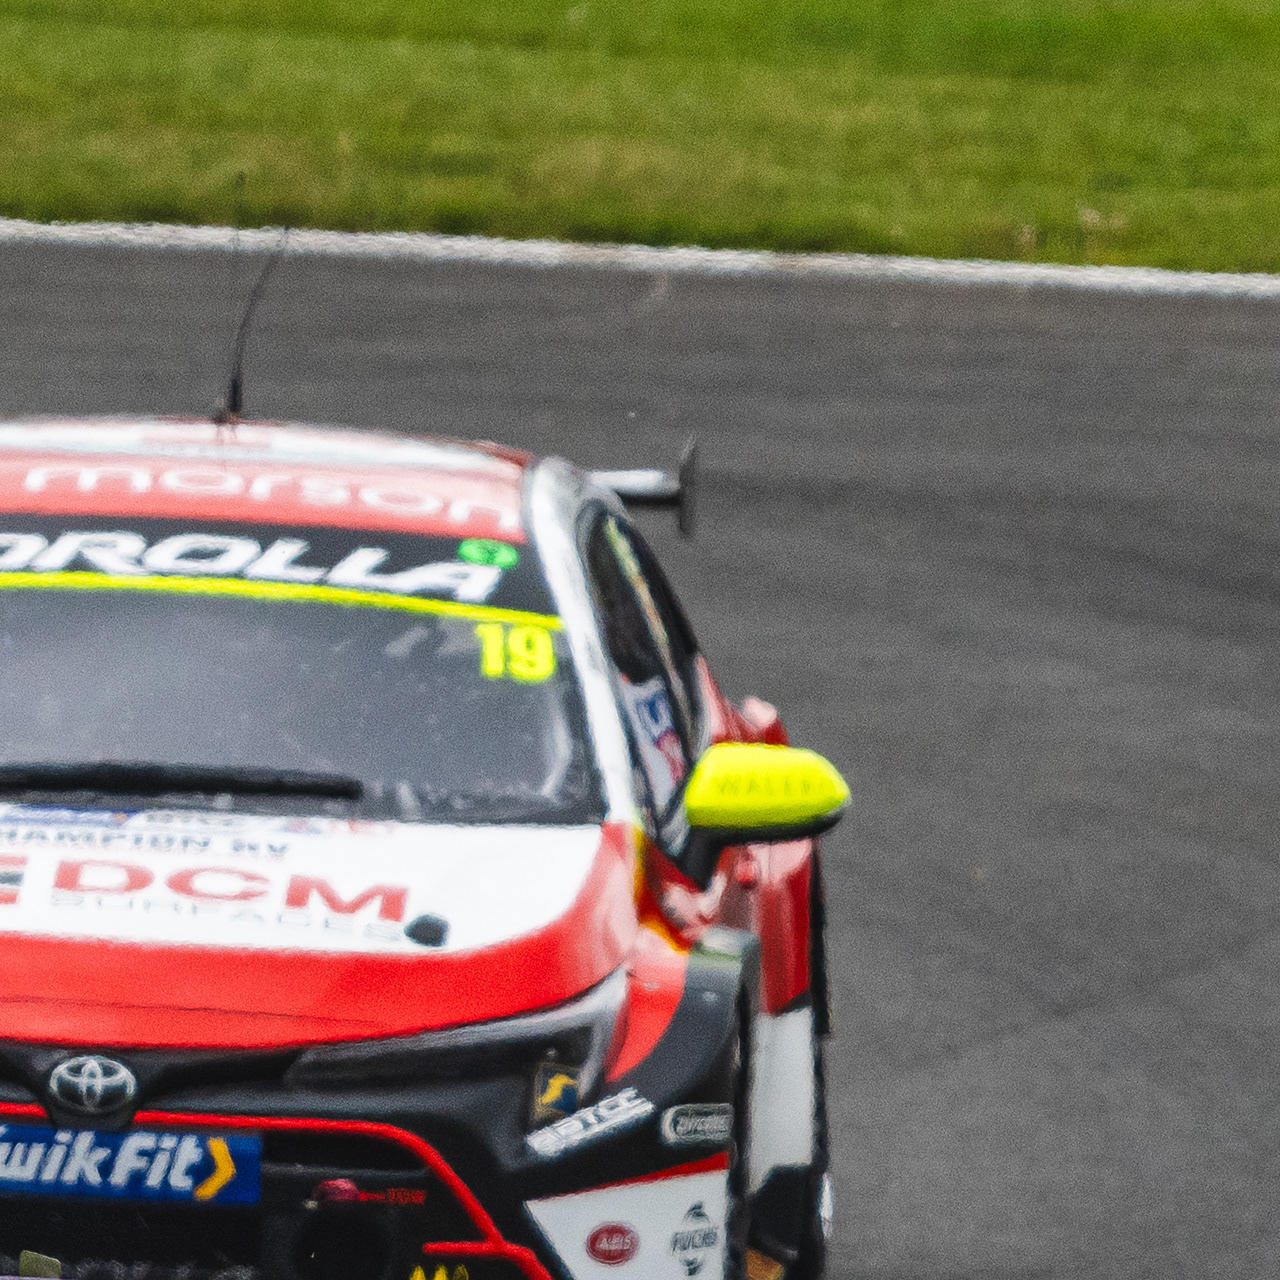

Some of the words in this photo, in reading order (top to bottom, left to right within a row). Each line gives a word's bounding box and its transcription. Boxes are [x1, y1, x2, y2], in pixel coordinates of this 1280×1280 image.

[24, 462, 520, 533] morson
[476, 623, 556, 683] 19
[53, 859, 409, 923] DCM
